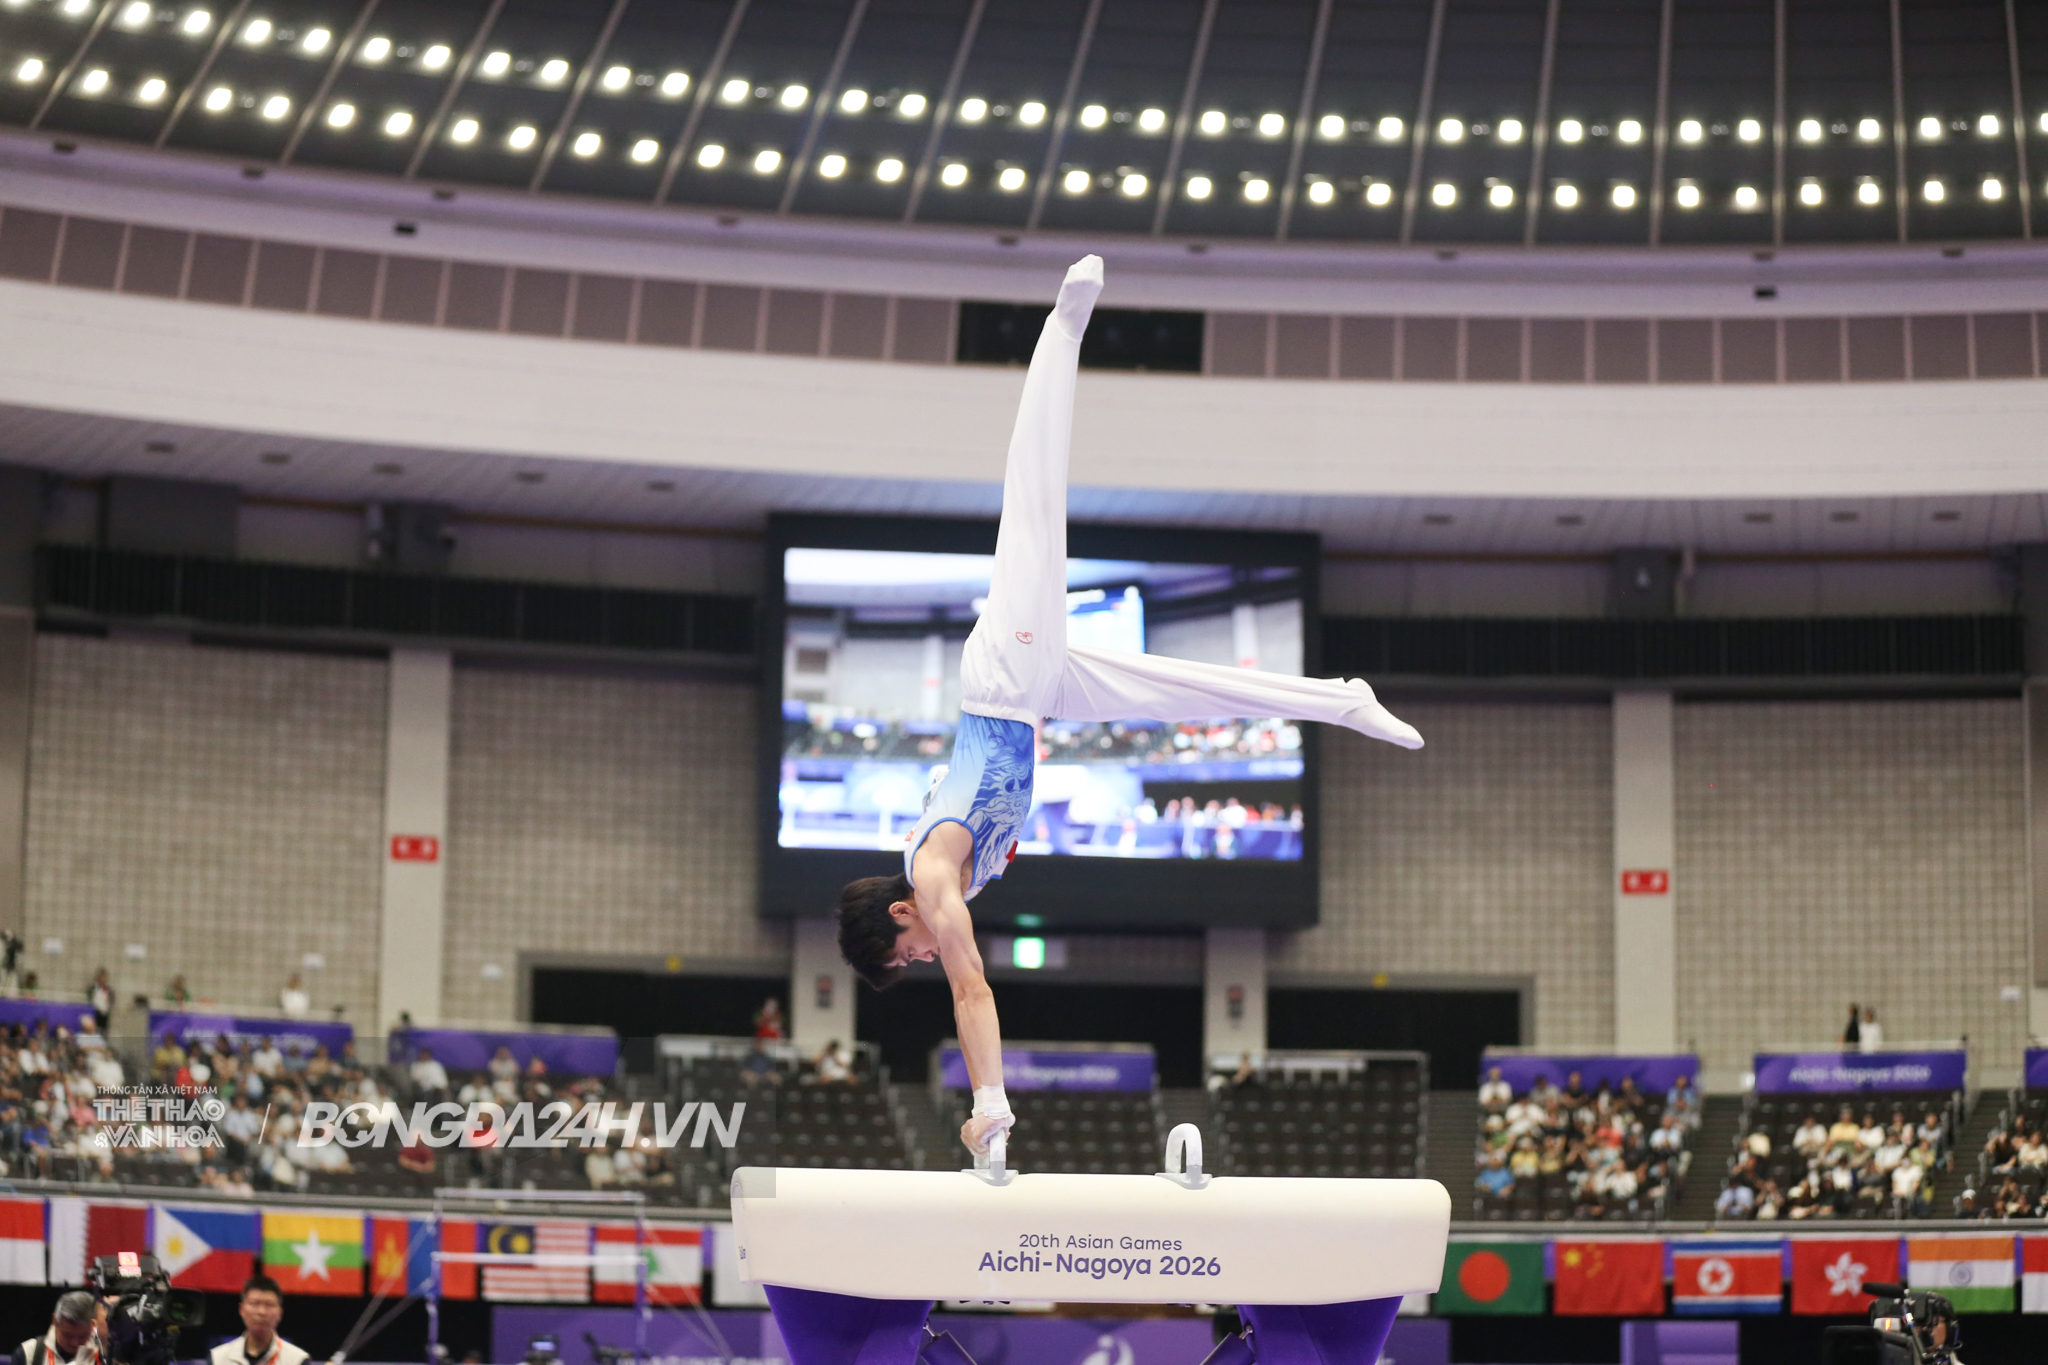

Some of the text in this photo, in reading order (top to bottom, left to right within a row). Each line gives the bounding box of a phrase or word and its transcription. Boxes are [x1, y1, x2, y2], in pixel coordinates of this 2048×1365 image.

[1019, 1233, 1183, 1251] 20th Asian Games
[978, 1250, 1222, 1280] Aichi-Nagoya 2026
